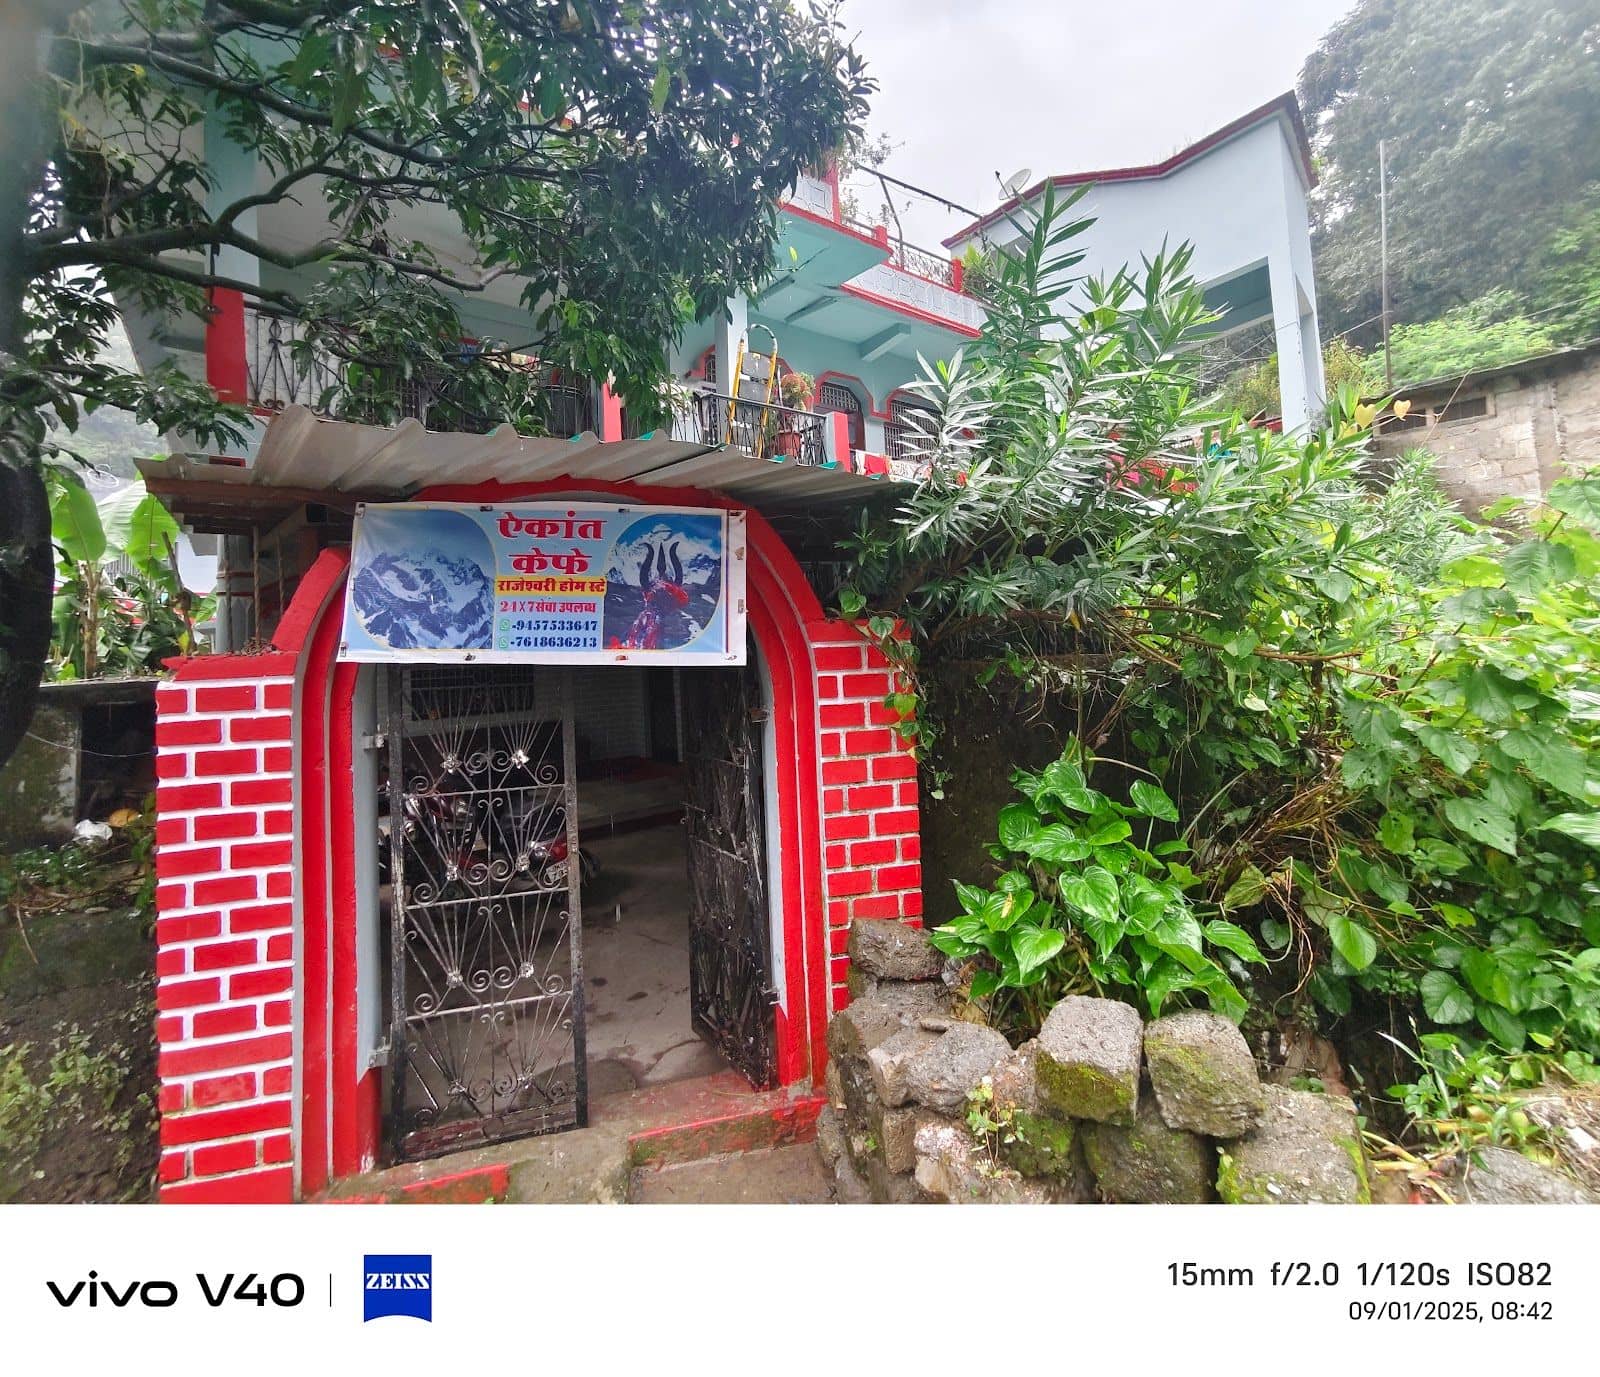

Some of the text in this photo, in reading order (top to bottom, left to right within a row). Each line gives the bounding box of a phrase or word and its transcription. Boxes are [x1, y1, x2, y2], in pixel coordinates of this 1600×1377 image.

[496, 510, 608, 540] ऐकांत
[508, 548, 592, 574] केफे
[498, 578, 606, 592] राजेश्वरी होम स्टे
